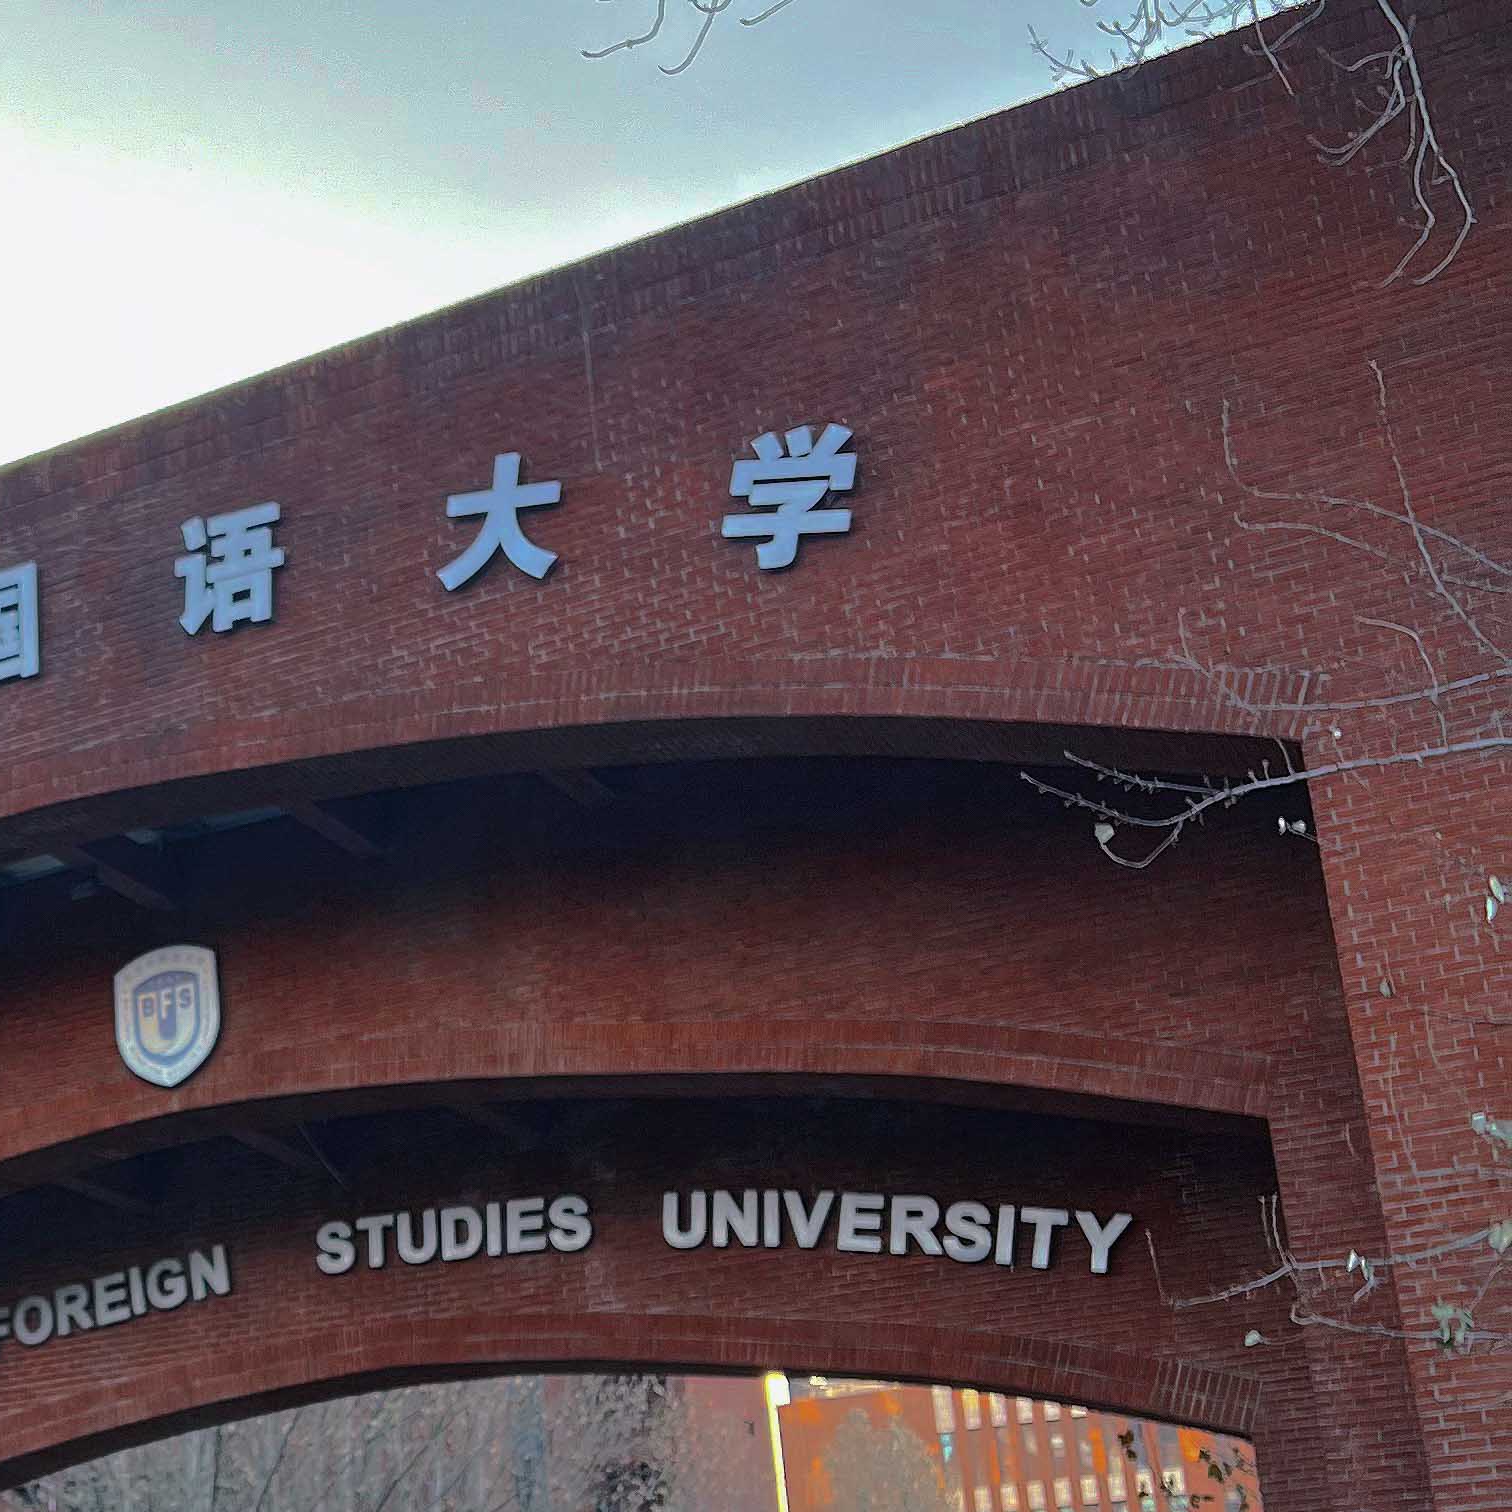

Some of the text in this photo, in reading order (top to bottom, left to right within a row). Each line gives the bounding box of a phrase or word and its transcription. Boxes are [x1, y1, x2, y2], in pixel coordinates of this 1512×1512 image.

[141, 987, 192, 1020] BFS
[315, 1195, 593, 1275] STUDIES
[661, 1188, 1134, 1274] UNIVERSITY
